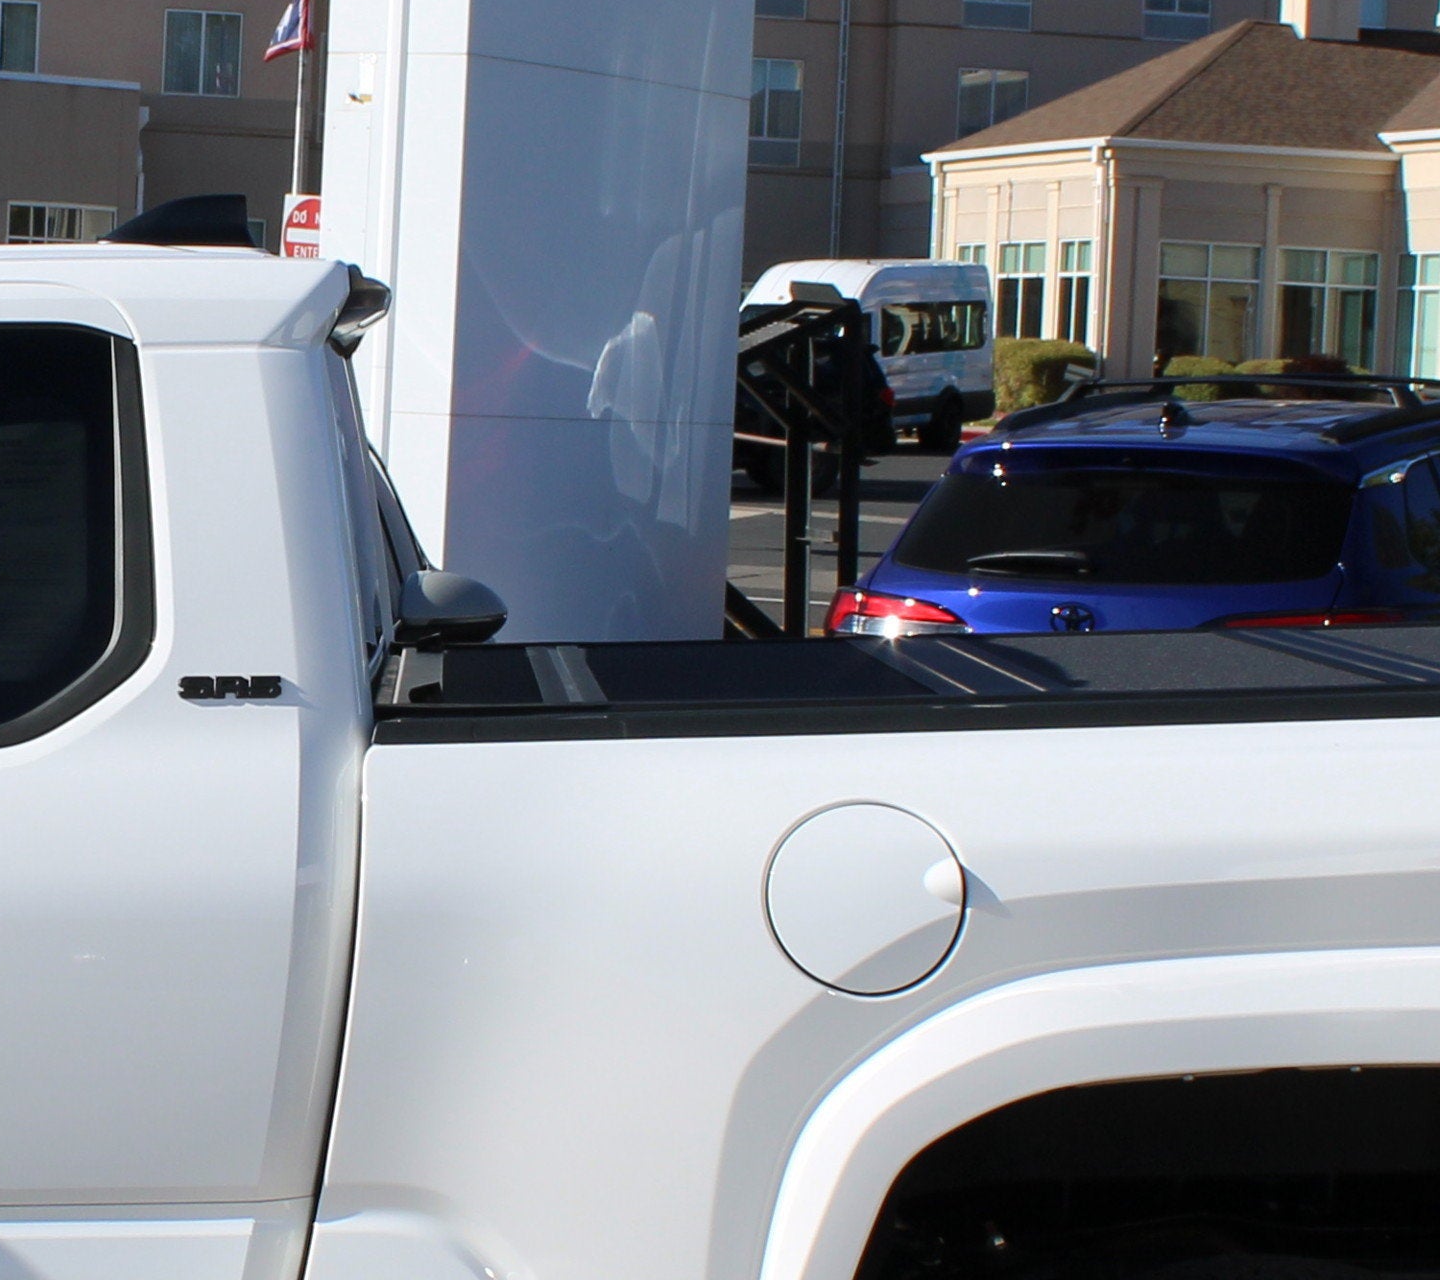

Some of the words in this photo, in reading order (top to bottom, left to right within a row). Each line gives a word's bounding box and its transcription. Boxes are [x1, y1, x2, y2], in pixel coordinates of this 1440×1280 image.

[292, 209, 308, 224] DO
[293, 245, 319, 258] ENTE
[178, 675, 282, 700] SR5
